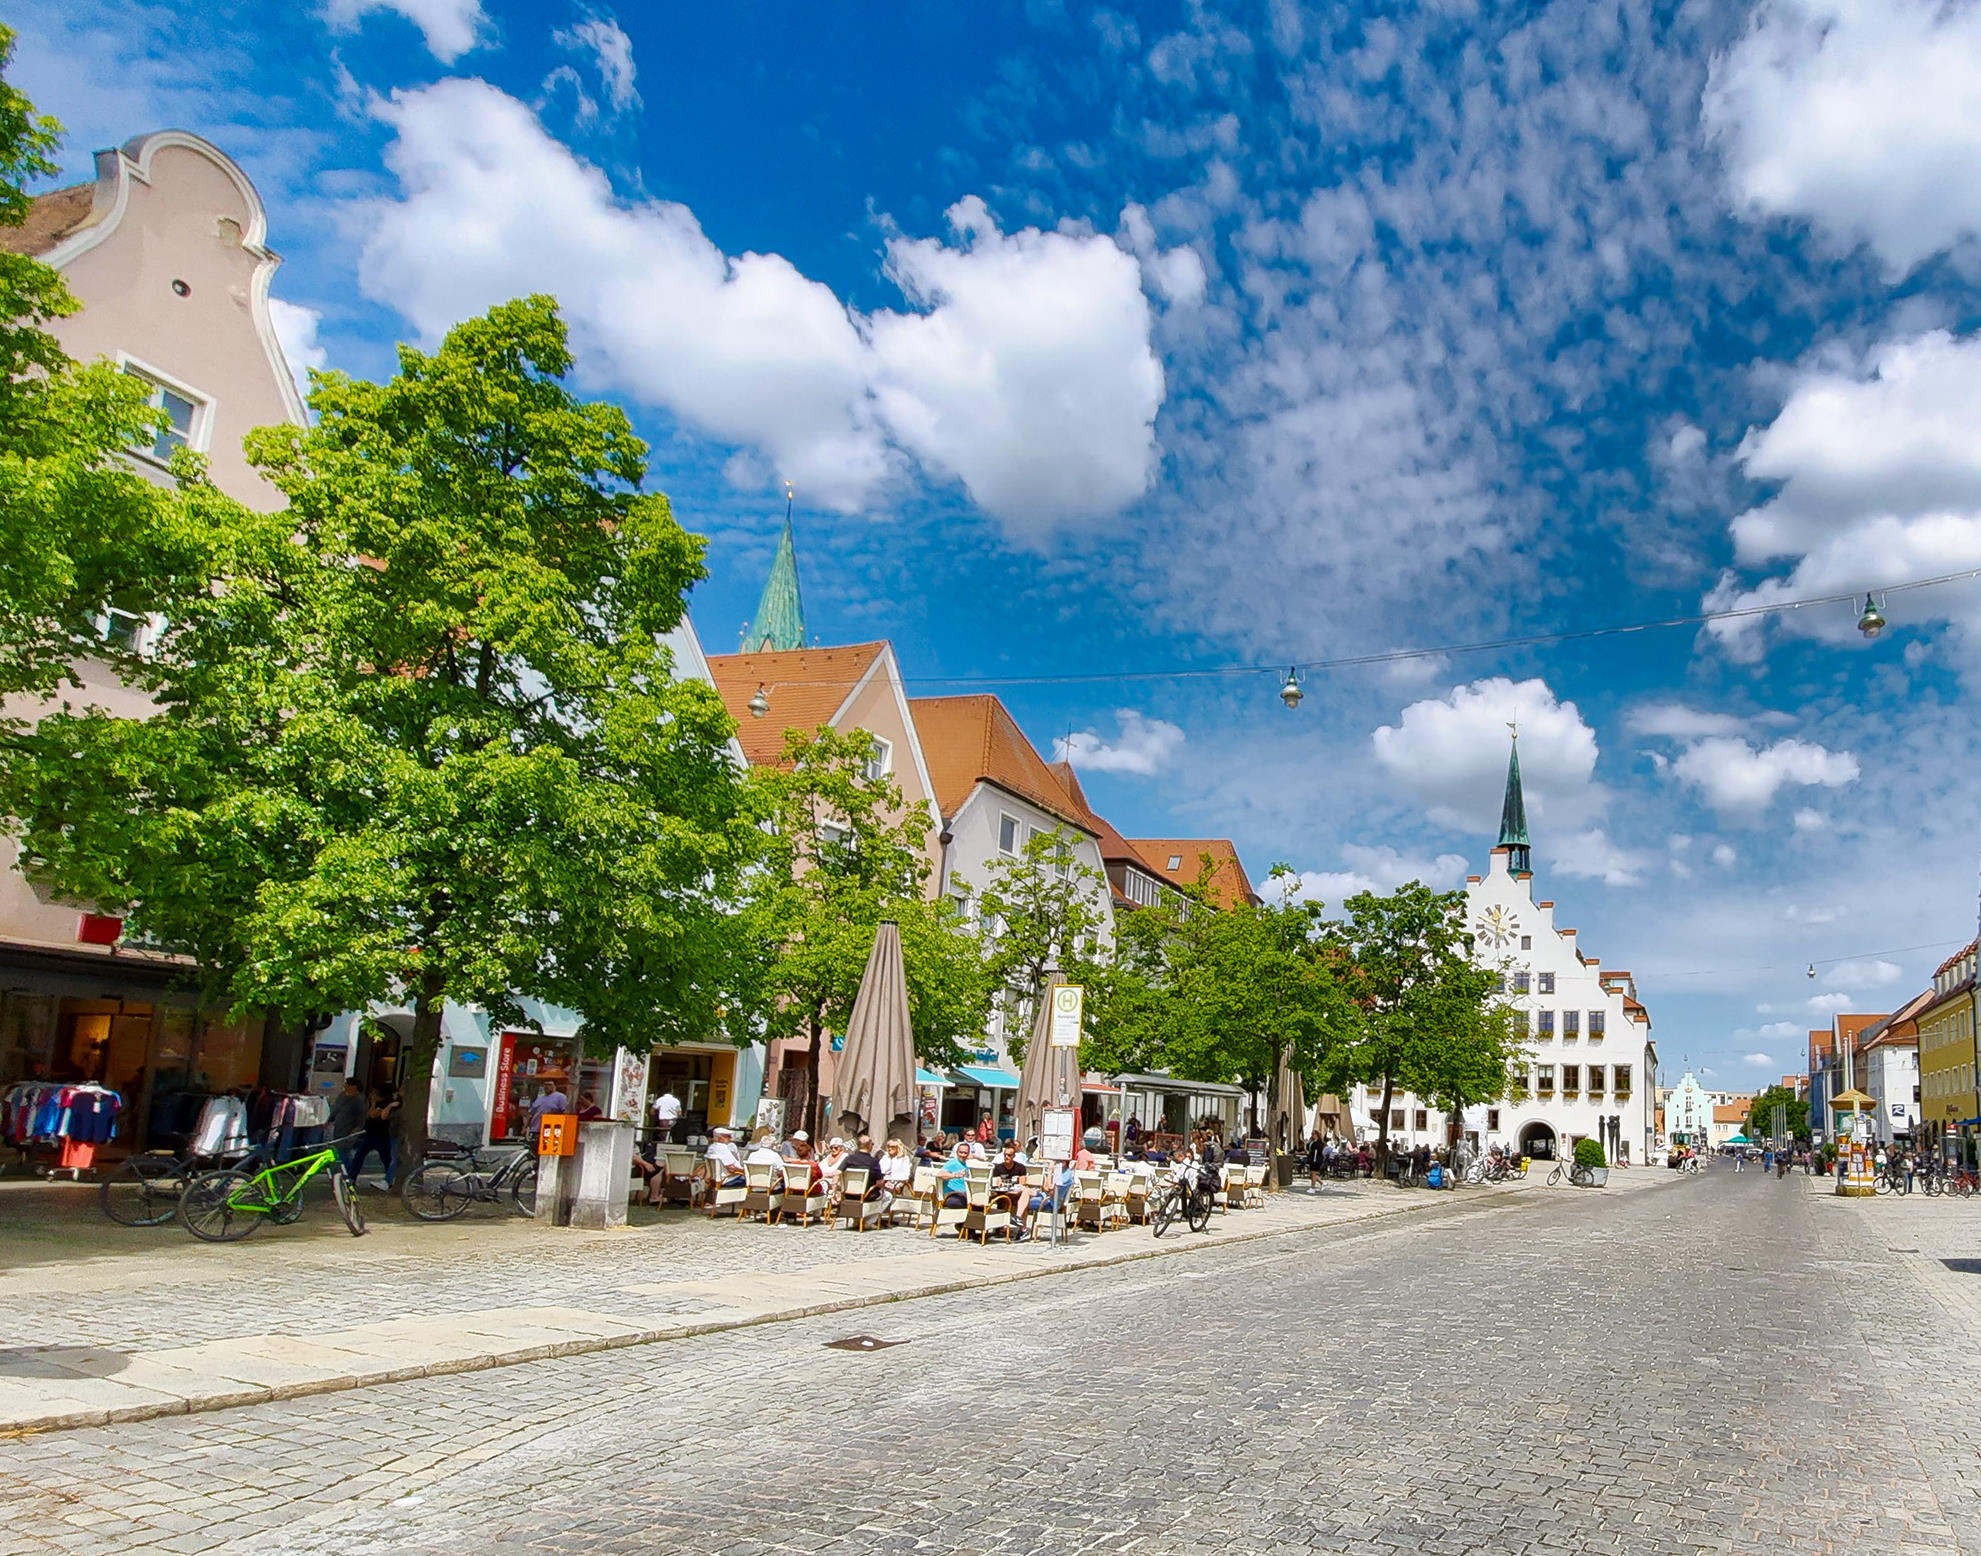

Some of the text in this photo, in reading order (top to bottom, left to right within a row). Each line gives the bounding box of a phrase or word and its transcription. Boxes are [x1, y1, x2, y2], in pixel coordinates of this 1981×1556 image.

[1063, 994, 1073, 1008] H
[496, 1047, 511, 1113] Business Store
[1892, 1104, 1905, 1116] R
